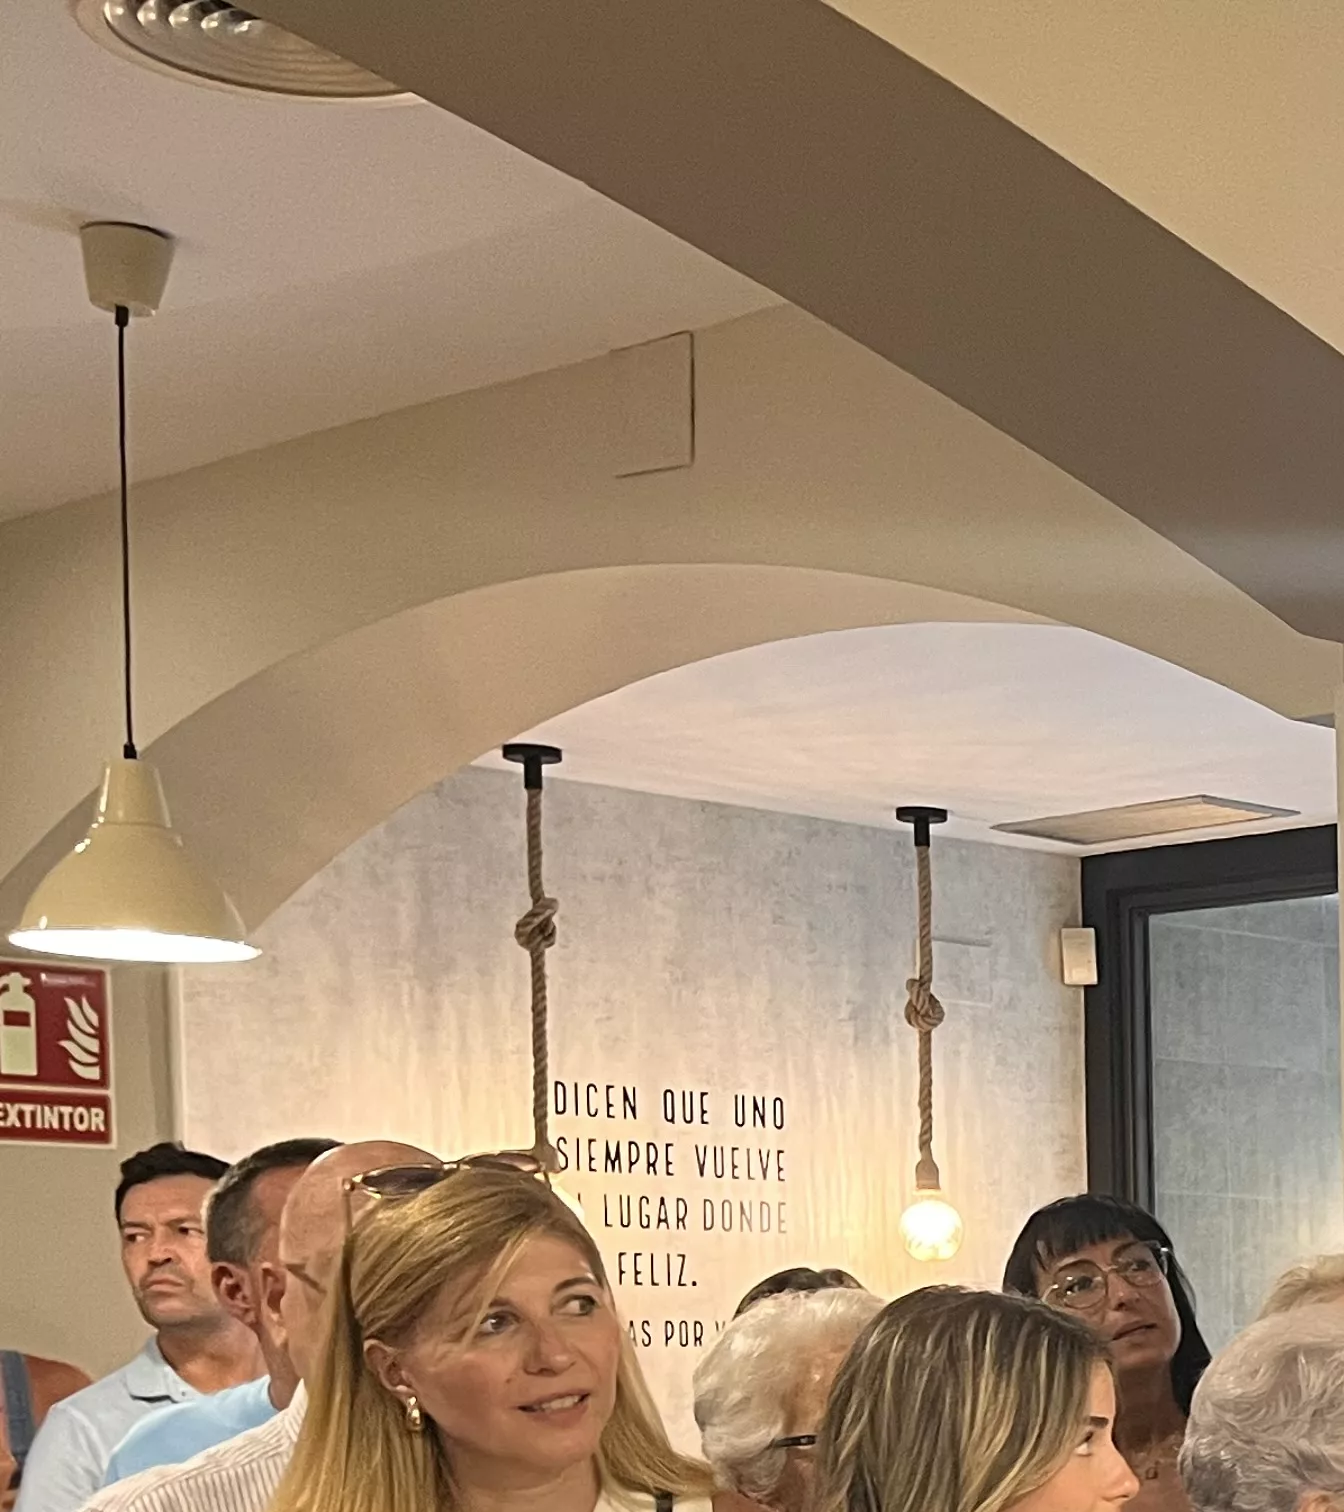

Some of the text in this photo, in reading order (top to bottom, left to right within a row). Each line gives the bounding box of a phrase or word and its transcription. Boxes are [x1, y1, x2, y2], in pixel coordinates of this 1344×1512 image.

[554, 1080, 784, 1130] DICEN QUE UNO
[556, 1136, 785, 1181] SIEMPRE VUELVE
[603, 1193, 688, 1230] LUGAR
[703, 1198, 787, 1234] DONDE
[618, 1251, 697, 1287] FELIZ.
[664, 1319, 704, 1348] POR
